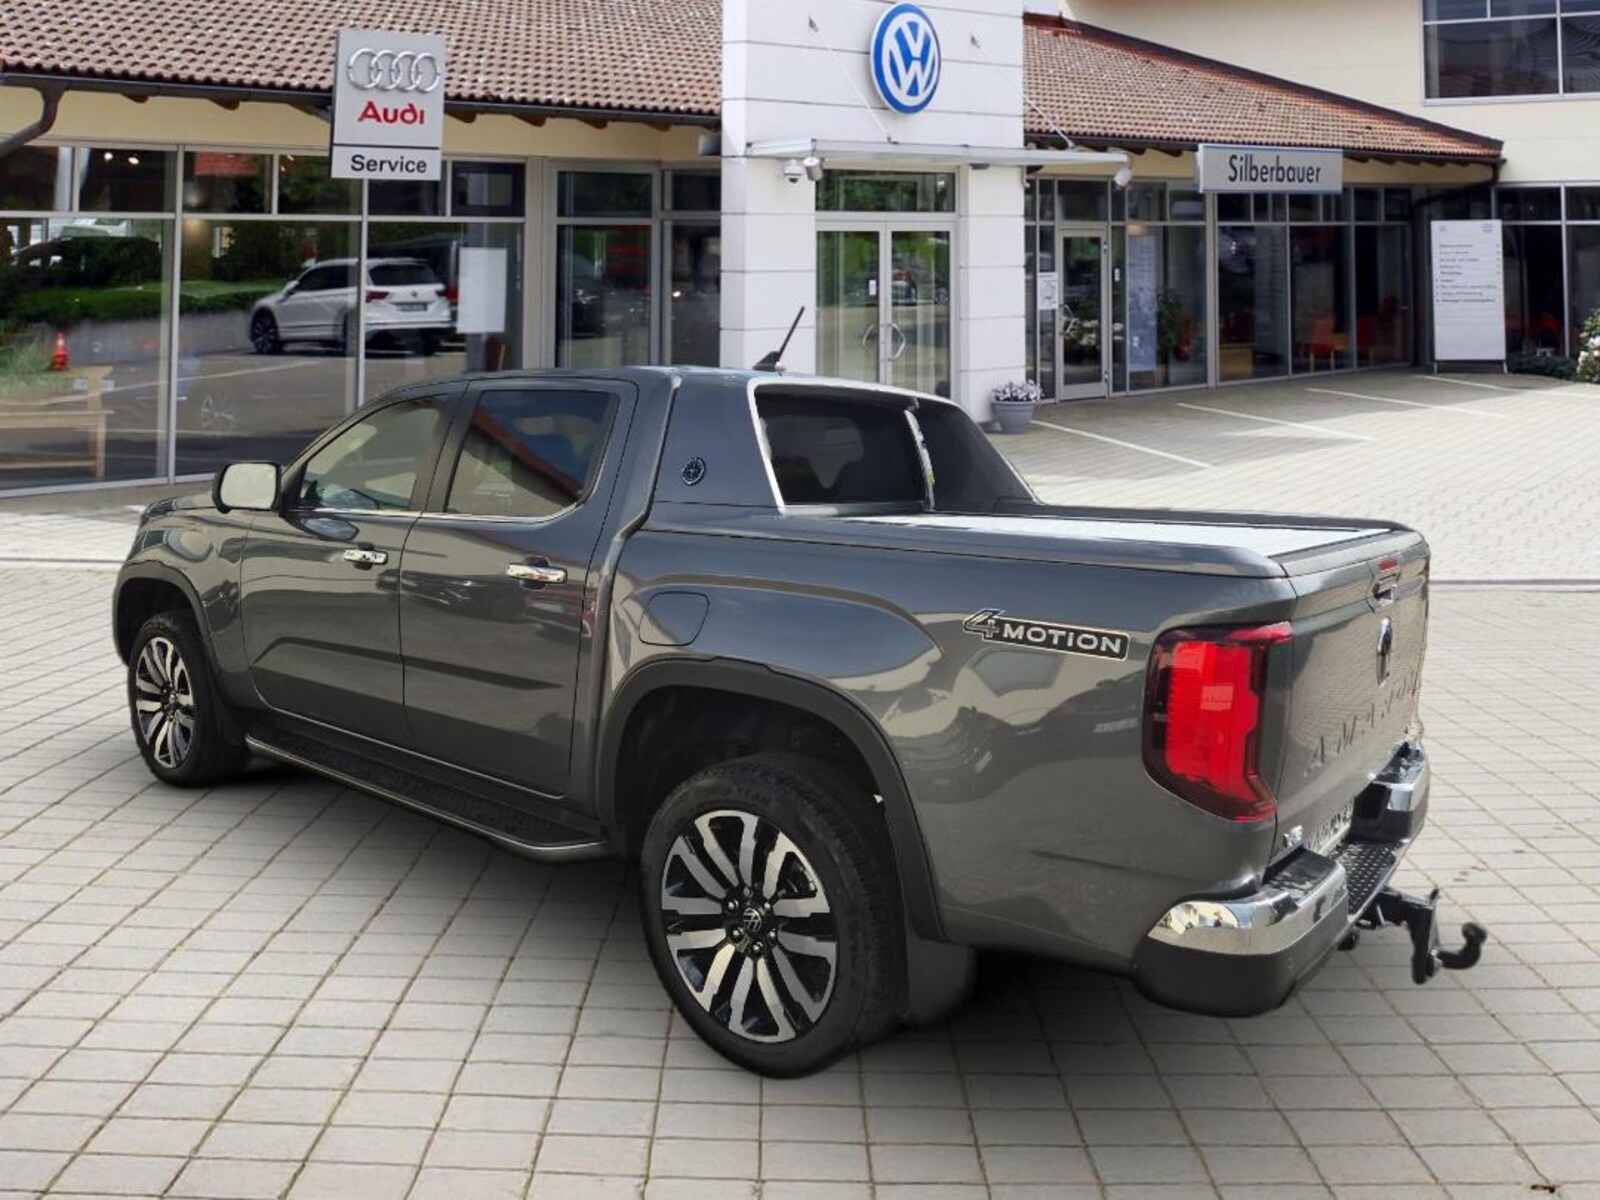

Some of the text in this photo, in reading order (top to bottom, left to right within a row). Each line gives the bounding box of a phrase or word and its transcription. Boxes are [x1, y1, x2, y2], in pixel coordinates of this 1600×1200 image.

[880, 11, 938, 107] VW
[357, 101, 425, 125] Audi
[351, 154, 427, 173] Service
[1228, 154, 1322, 183] Silberbauer
[963, 608, 1121, 653] 4MOTION
